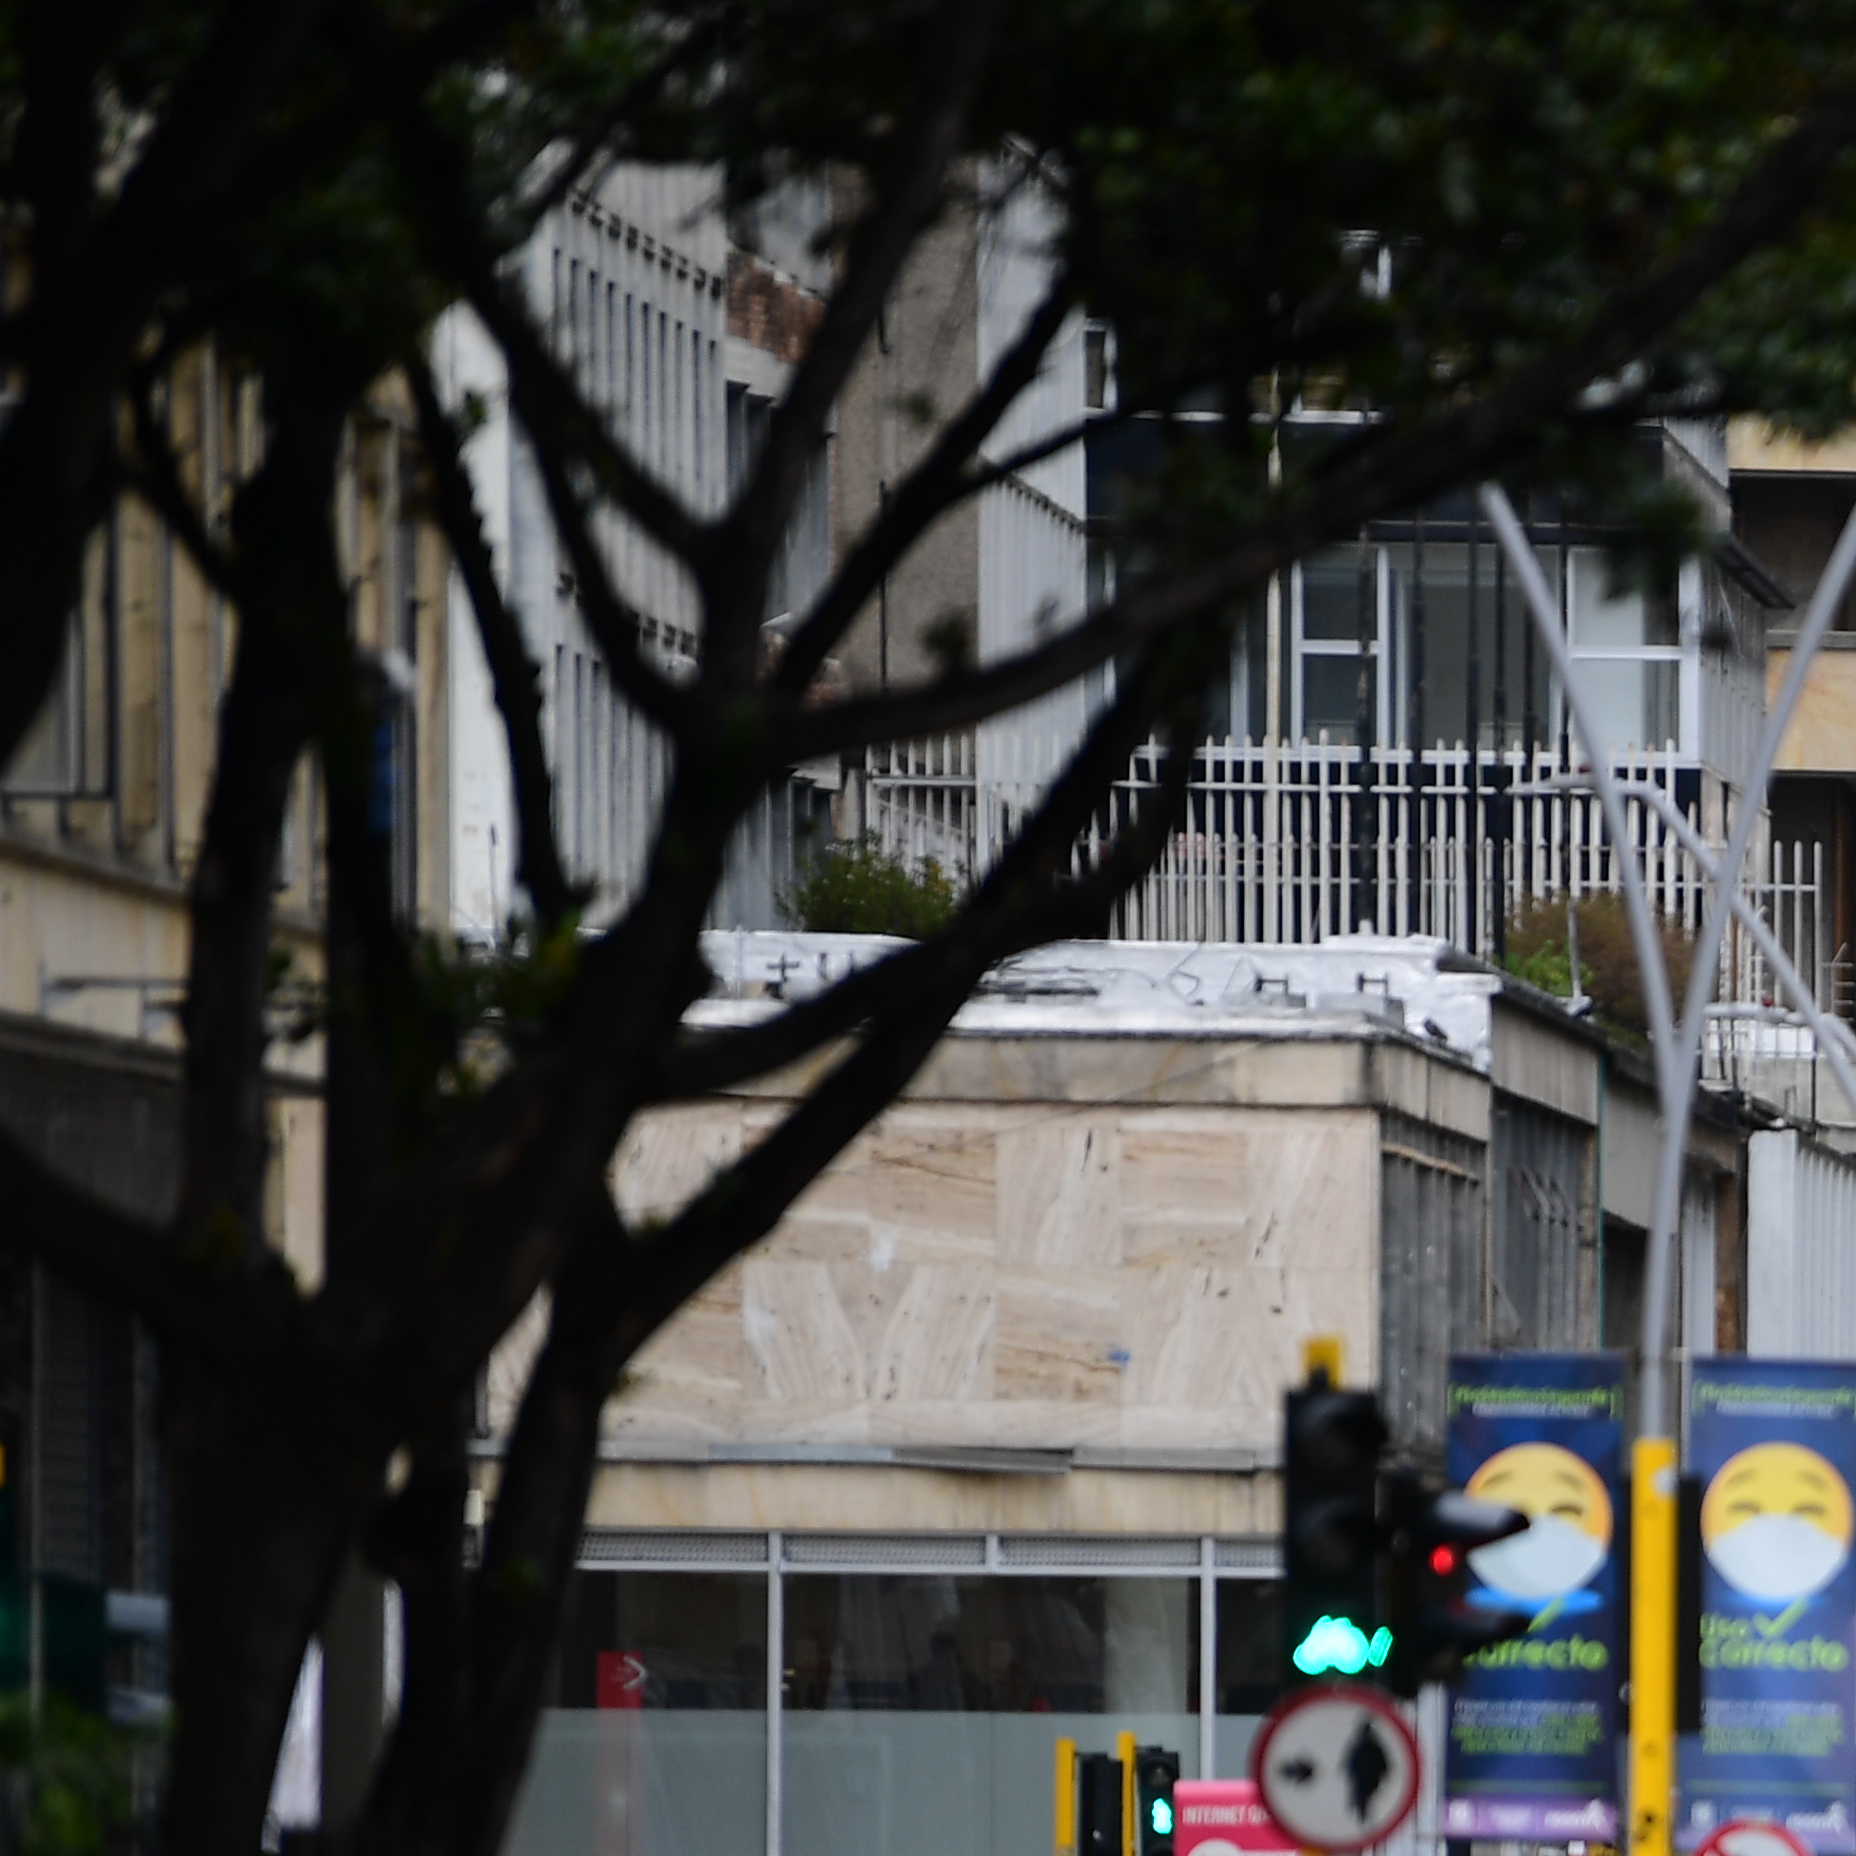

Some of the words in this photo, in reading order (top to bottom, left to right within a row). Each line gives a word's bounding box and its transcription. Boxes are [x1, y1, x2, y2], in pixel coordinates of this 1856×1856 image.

[1462, 1634, 1609, 1671] orrecto
[1700, 1634, 1849, 1672] Correcto
[1182, 1805, 1244, 1825] INTERNET
